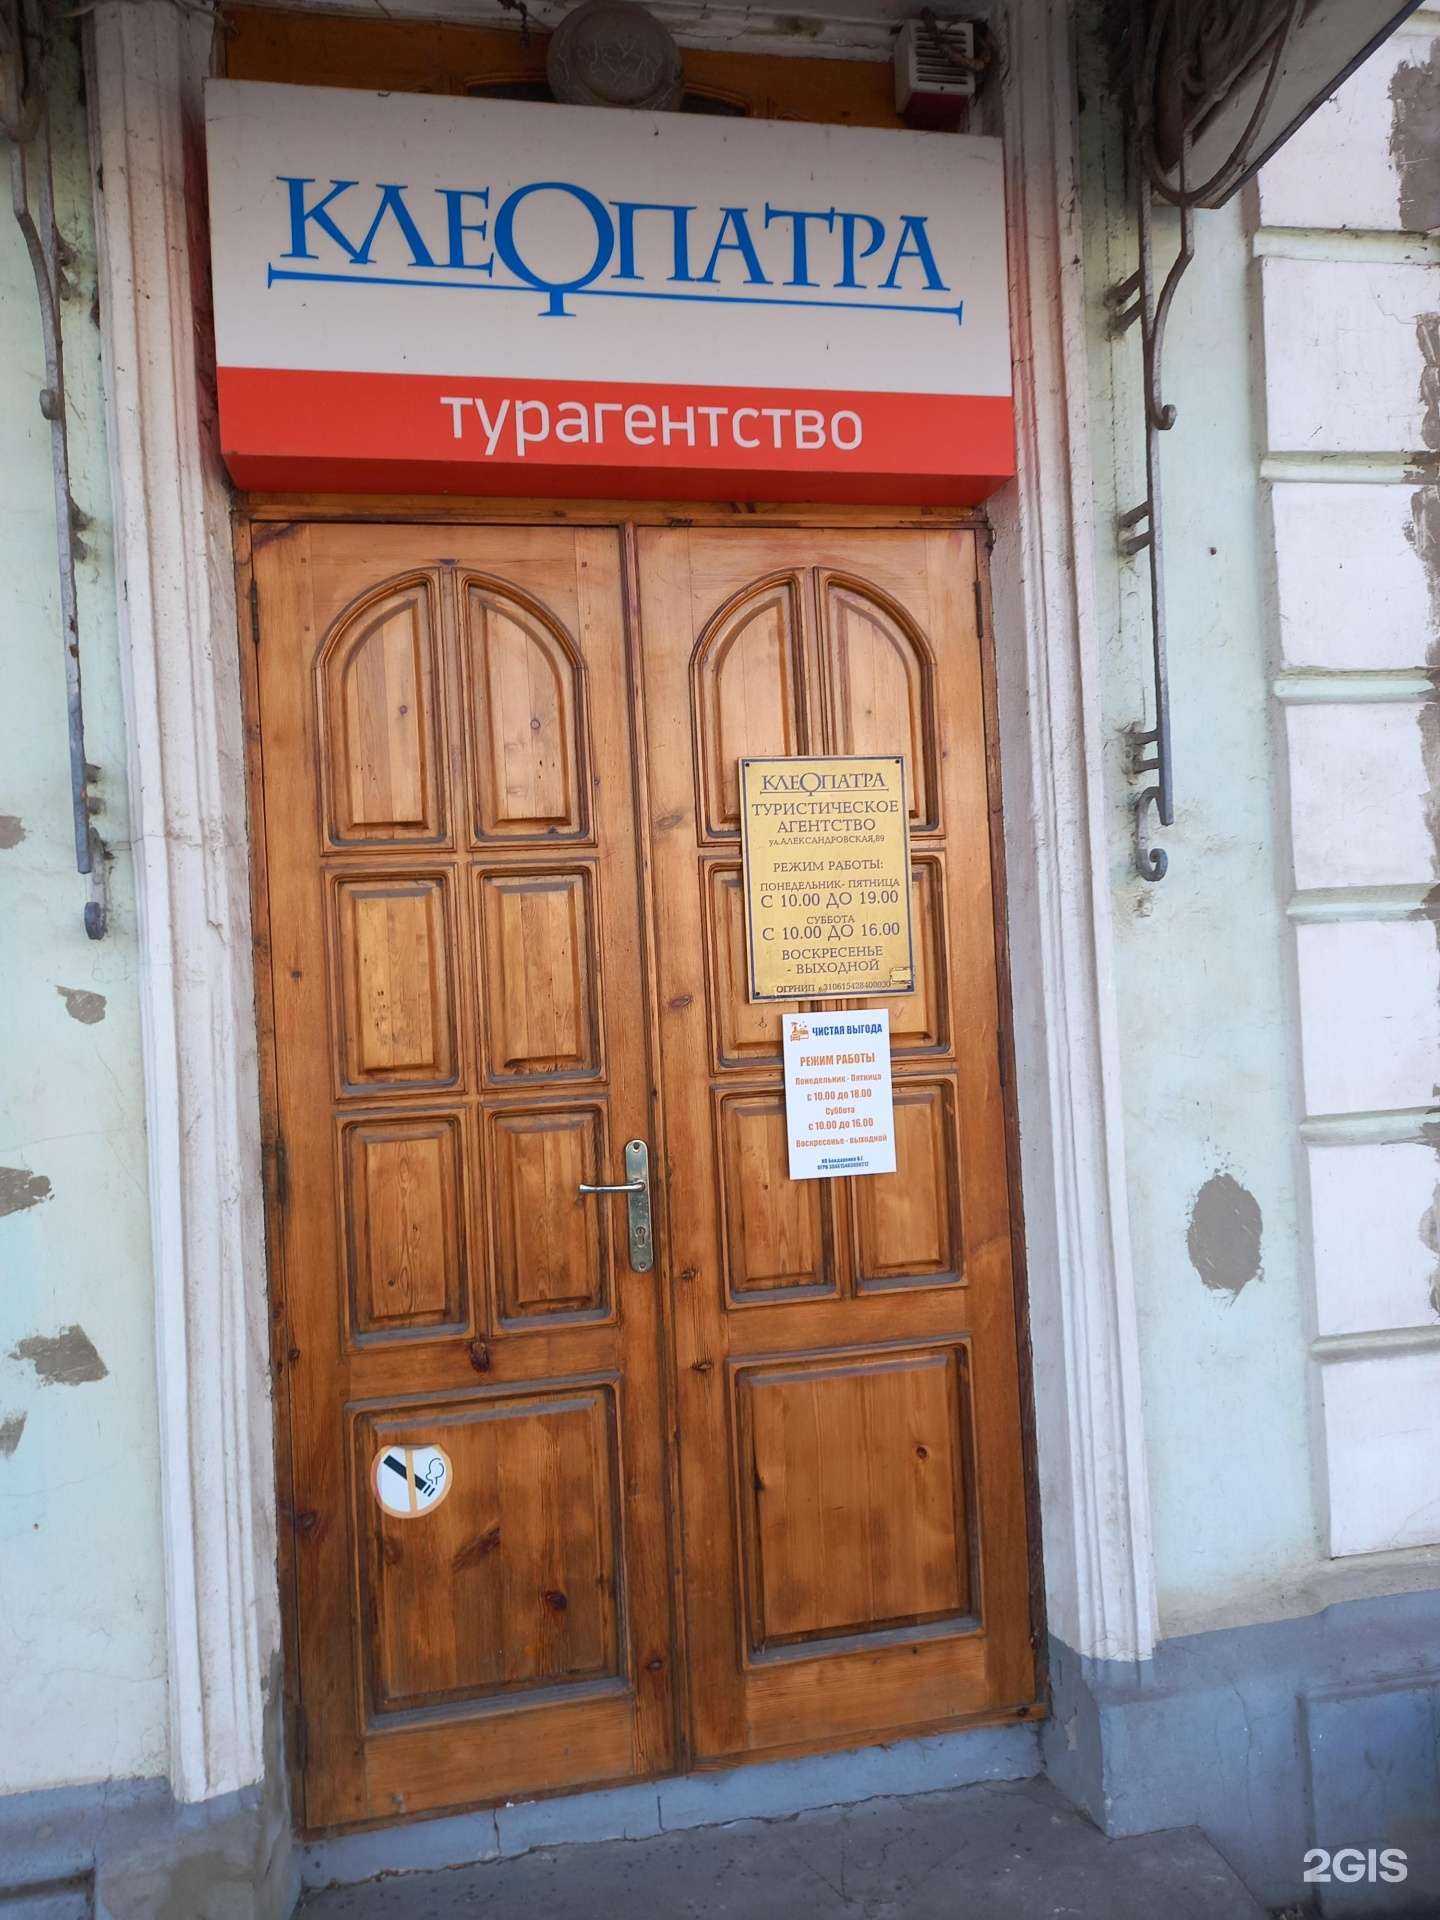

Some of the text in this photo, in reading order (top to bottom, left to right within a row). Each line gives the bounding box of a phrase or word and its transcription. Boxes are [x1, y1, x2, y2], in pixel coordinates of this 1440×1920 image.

[275, 175, 950, 317] КЛЕОПАТРА
[440, 395, 863, 456] турагентство
[762, 772, 885, 796] КЛЕОПАТРА
[752, 800, 899, 816] ТУРИСТИЧЕСКОЕ
[777, 819, 875, 833] АГЕНТСТВО
[773, 859, 883, 872] РЕЖИМ РАБОТЫ:
[848, 879, 900, 888] ПЯТНИЦА
[761, 890, 898, 908] С 10.00 ДО 19.00
[807, 915, 855, 924] СУББОТА
[762, 923, 899, 941] С 10.00 ДО 16.00
[782, 946, 883, 960] ВОСКРЕСЕНЬЕ
[796, 960, 880, 974] ВЫХОДНОЙ
[776, 984, 815, 993] ОГРНИП
[812, 1024, 882, 1036] ЧИСТАЯ ВЫГОДА
[800, 1053, 875, 1066] РЕЖИМ РАБОТЫ
[814, 1091, 835, 1100] 10.00
[838, 1092, 848, 1100] до
[851, 1089, 871, 1098] 18.00
[826, 1106, 855, 1116] Суббота
[816, 1121, 836, 1130] 10.00
[852, 1118, 873, 1127] 16.00
